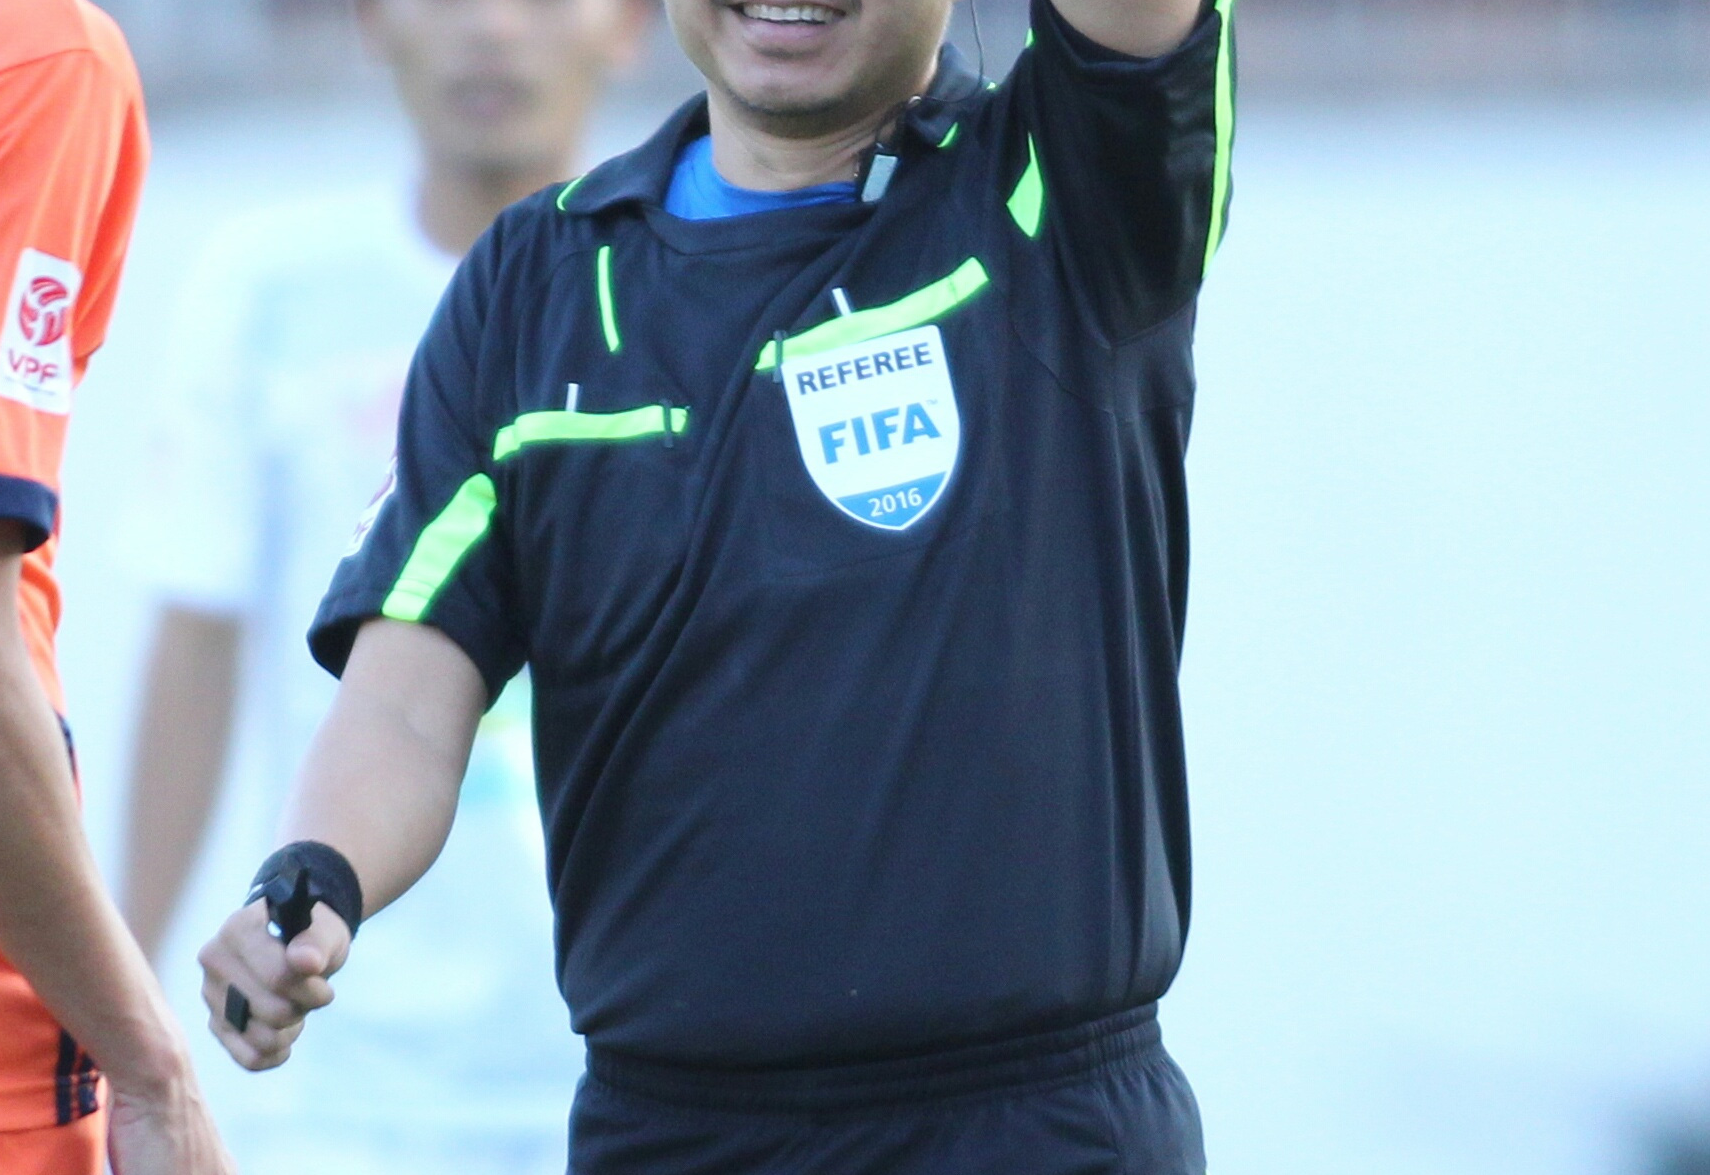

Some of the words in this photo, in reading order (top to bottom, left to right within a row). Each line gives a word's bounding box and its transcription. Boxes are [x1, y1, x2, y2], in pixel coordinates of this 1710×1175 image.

[8, 348, 59, 383] VPF
[796, 342, 933, 395] REFEREE
[818, 402, 942, 465] FIFA
[867, 487, 923, 517] 2016
